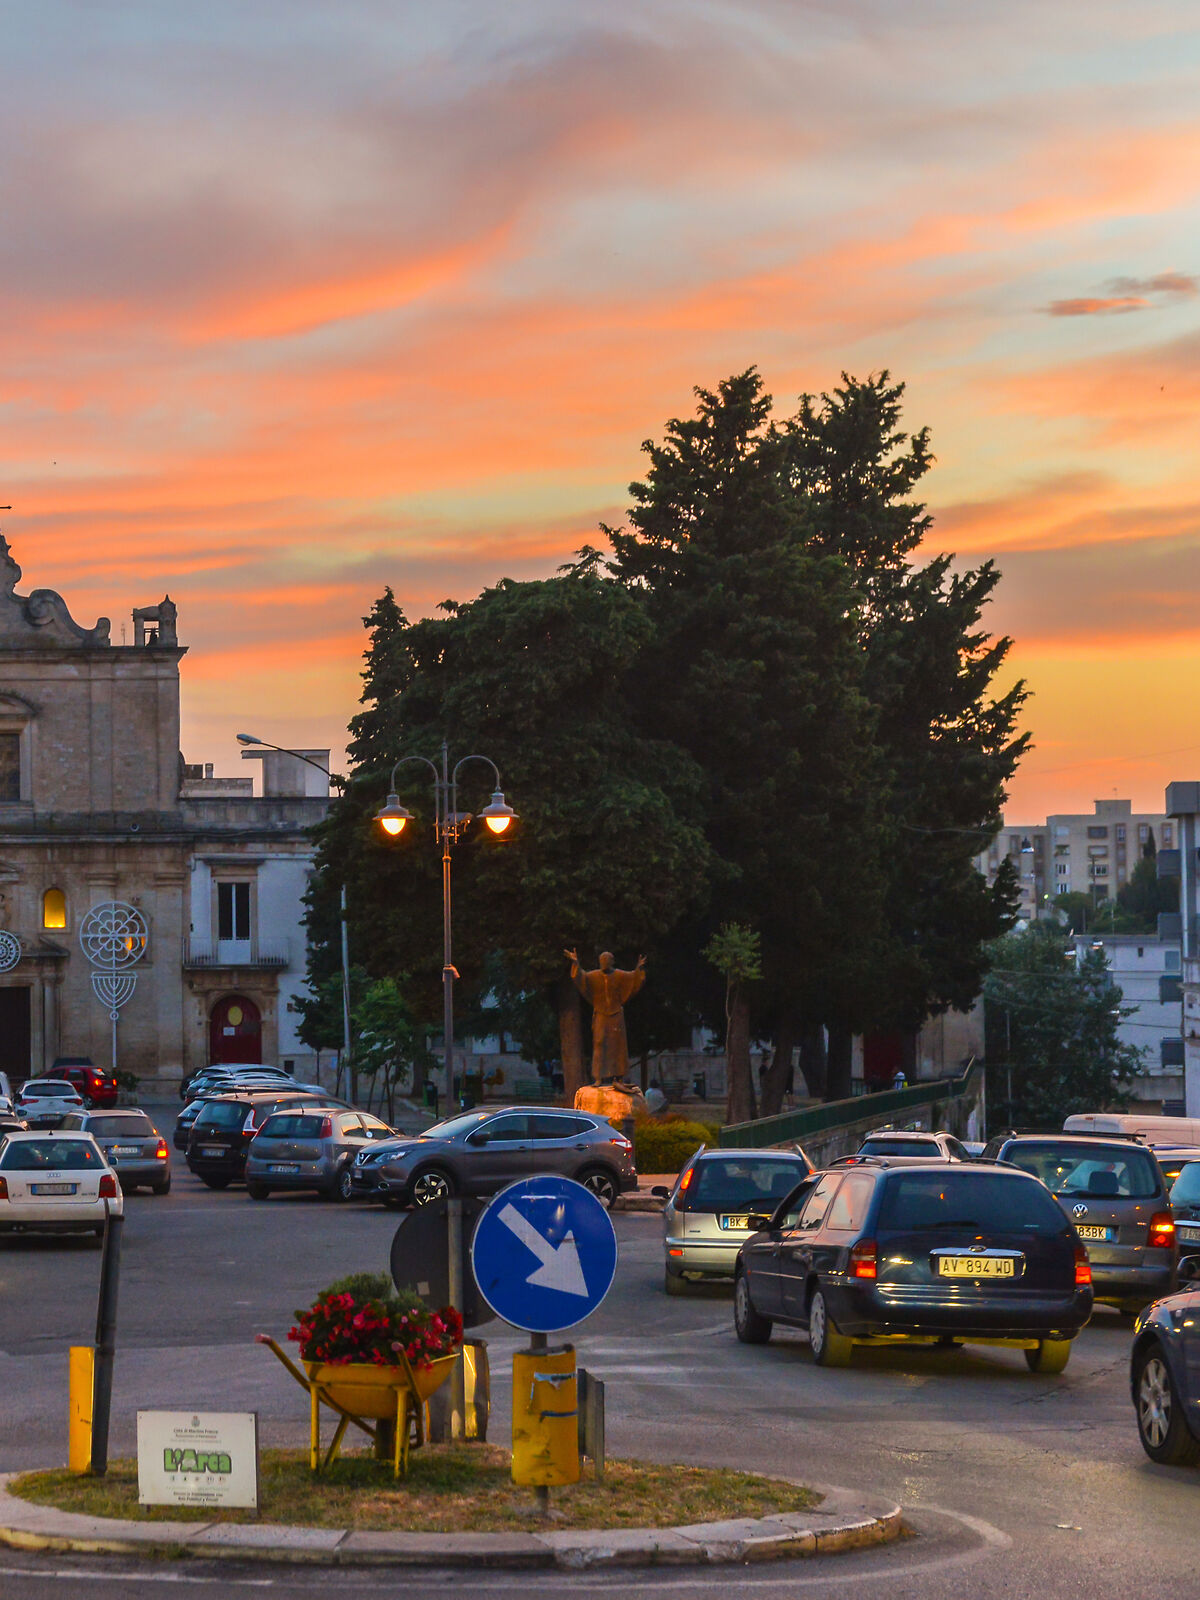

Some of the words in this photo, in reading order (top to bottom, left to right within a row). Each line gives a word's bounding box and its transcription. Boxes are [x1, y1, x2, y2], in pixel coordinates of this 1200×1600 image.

[943, 1259, 958, 1273] AV
[966, 1260, 990, 1274] 894
[995, 1260, 1011, 1275] WD
[163, 1448, 232, 1474] L'Arca
